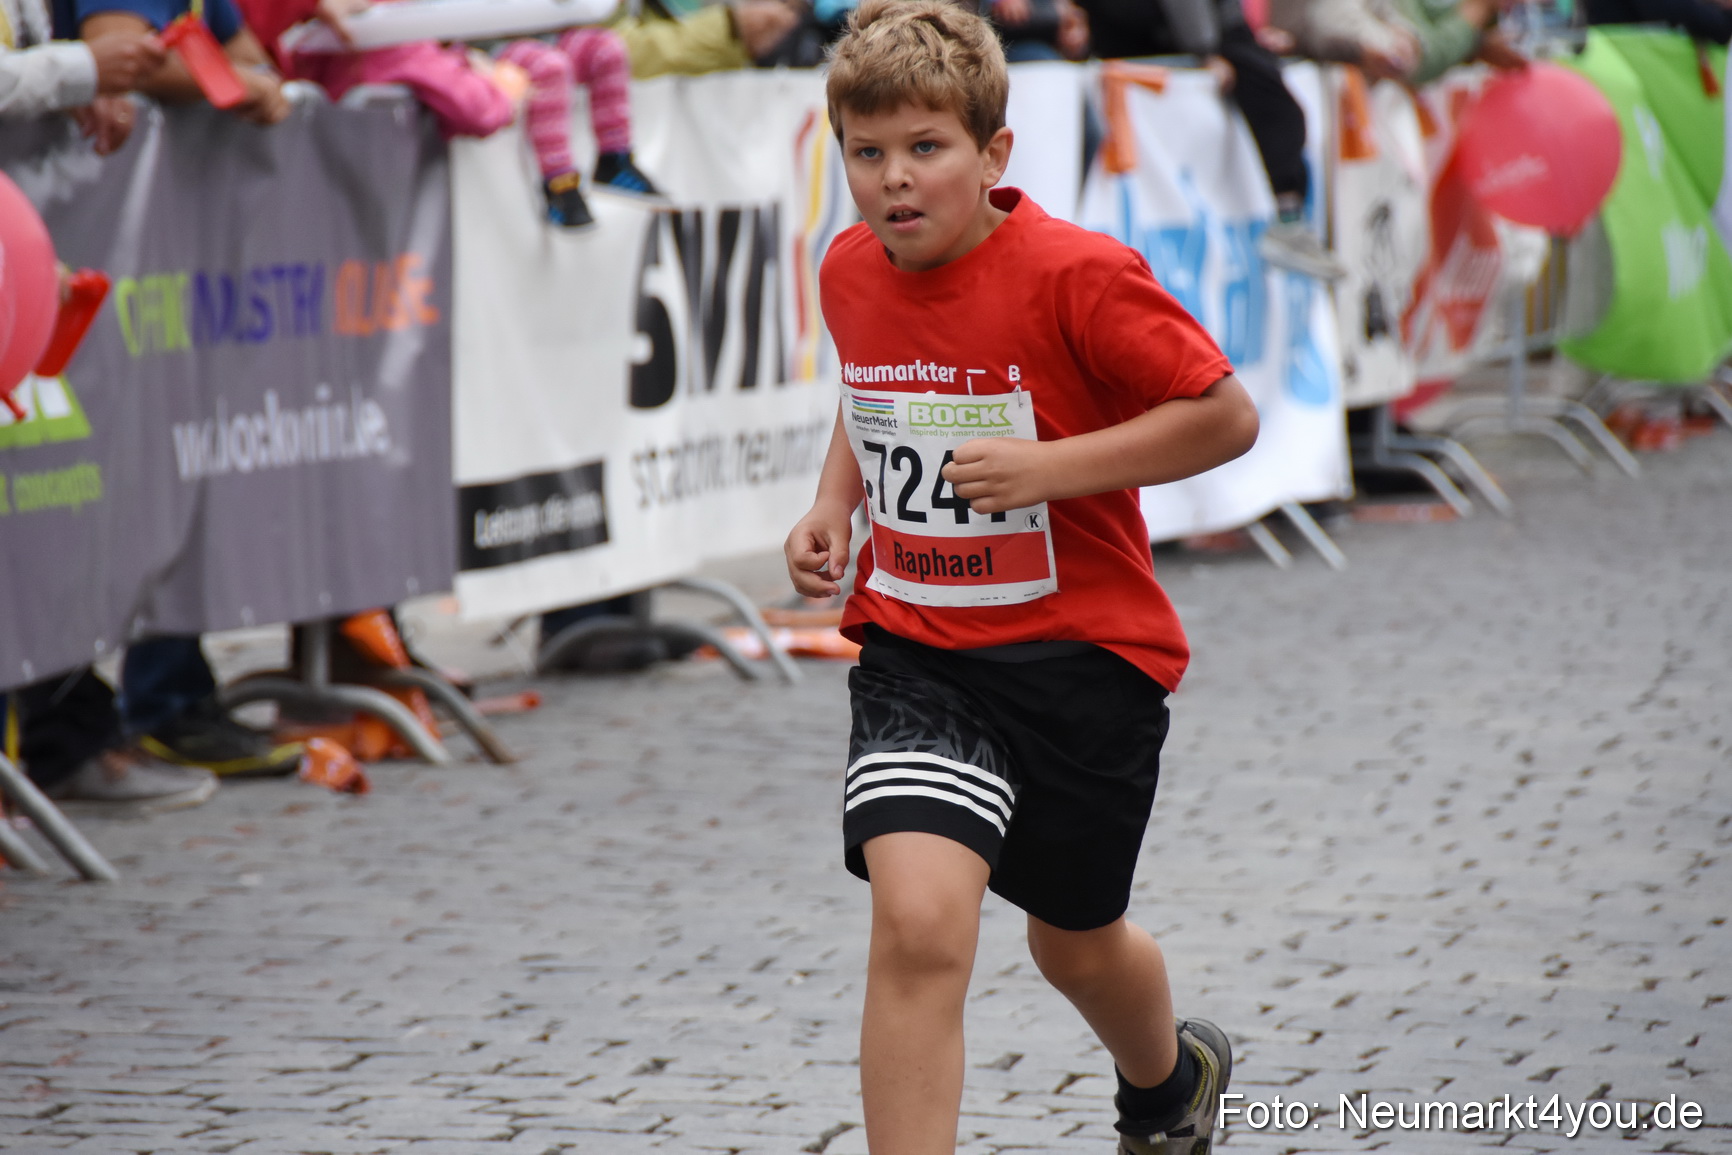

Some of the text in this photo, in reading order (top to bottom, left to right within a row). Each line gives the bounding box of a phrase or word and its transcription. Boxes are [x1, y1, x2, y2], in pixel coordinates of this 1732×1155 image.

[844, 360, 957, 383] Neumarkter
[851, 411, 898, 429] NeuerMarkt
[909, 402, 1011, 427] BOCK
[909, 428, 1015, 438] inspired by smart concepts
[863, 440, 1006, 524] 724
[1029, 515, 1039, 528] K
[894, 541, 994, 582] Raphael
